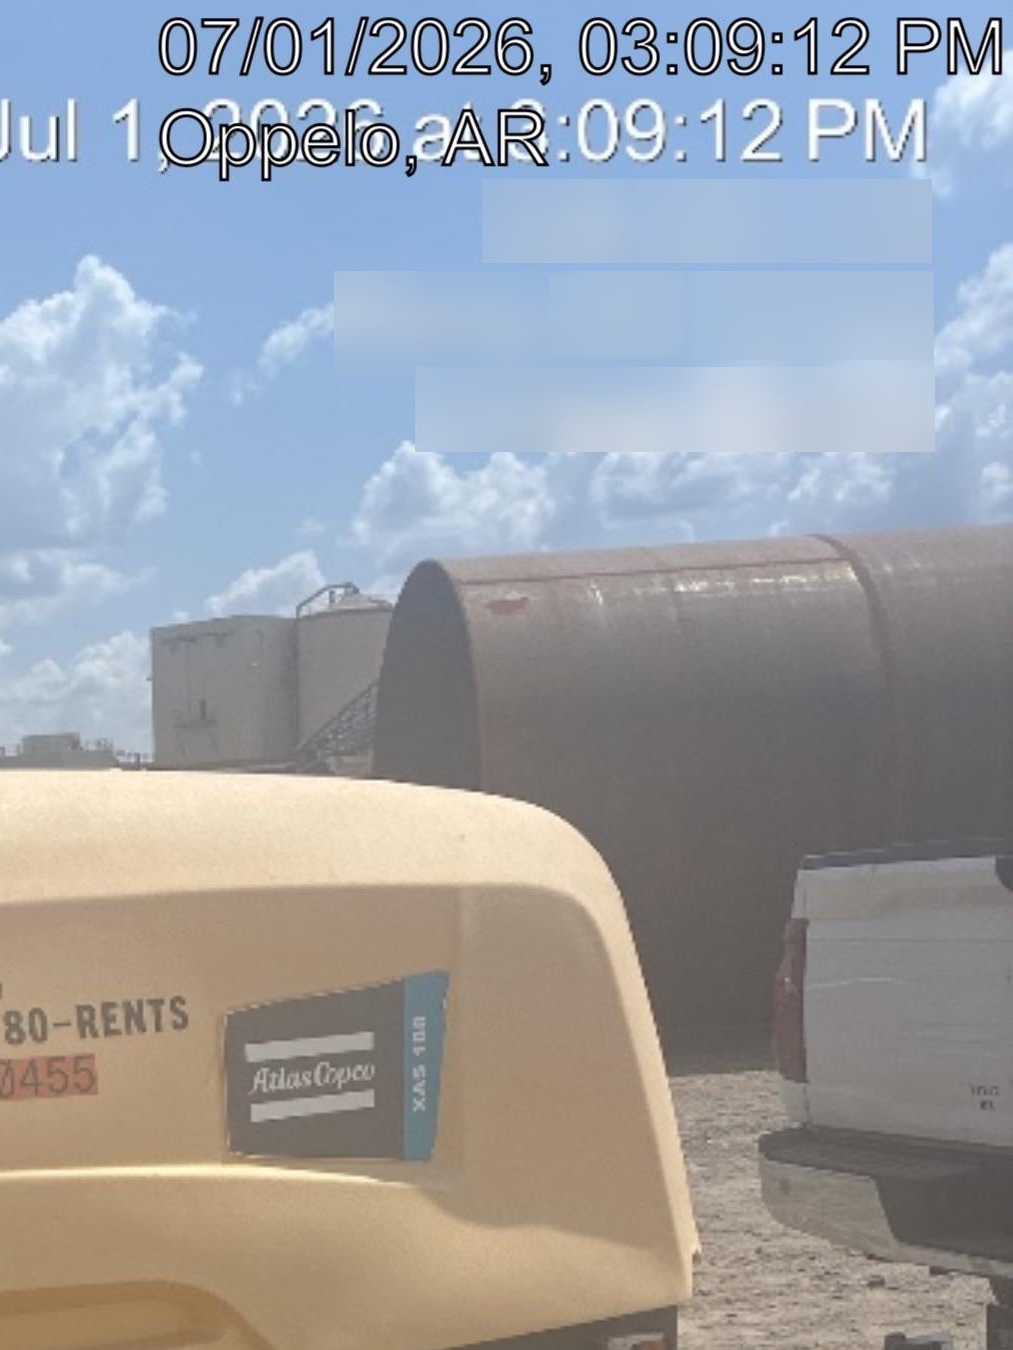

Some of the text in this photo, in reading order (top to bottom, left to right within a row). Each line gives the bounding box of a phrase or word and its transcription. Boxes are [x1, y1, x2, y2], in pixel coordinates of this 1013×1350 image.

[249, 1061, 375, 1095] Atlas Copco
[412, 1064, 426, 1112] XAS
